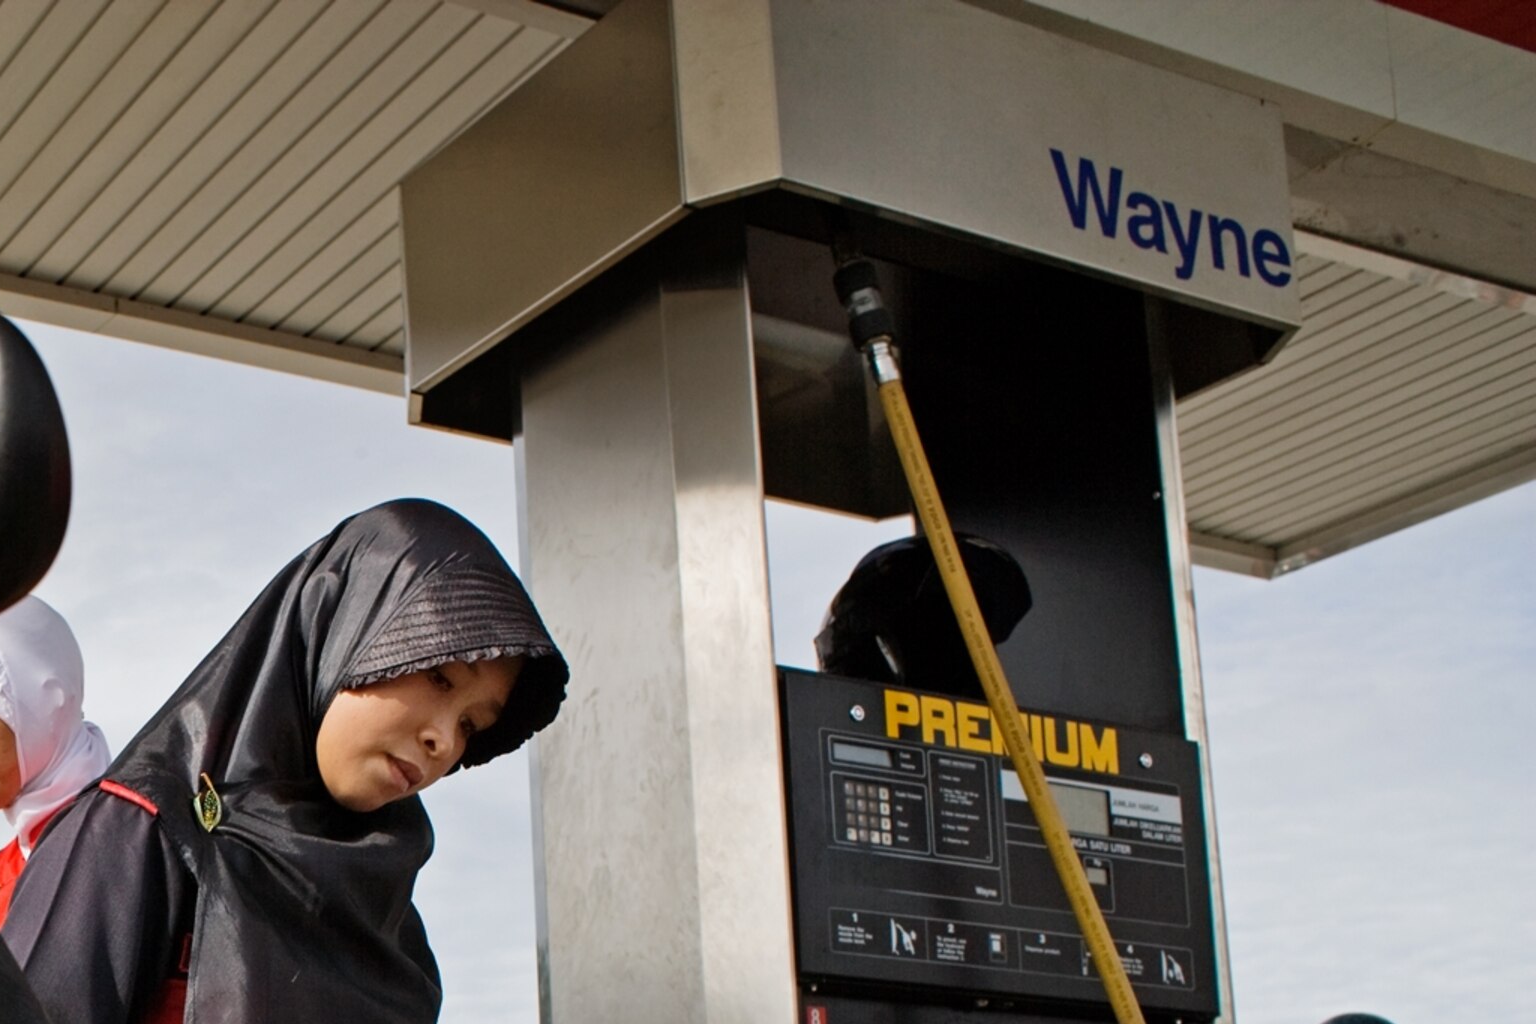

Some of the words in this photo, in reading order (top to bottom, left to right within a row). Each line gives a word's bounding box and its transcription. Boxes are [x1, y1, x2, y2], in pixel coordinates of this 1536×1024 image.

[1048, 147, 1292, 288] Wayne
[1113, 817, 1138, 828] JUMLAH
[1165, 833, 1183, 843] LITER
[1089, 839, 1109, 852] SATU
[1110, 843, 1132, 855] LITER
[852, 912, 859, 923] 1
[946, 923, 955, 934] 2
[1038, 933, 1046, 945] 3
[1125, 943, 1134, 955] 4
